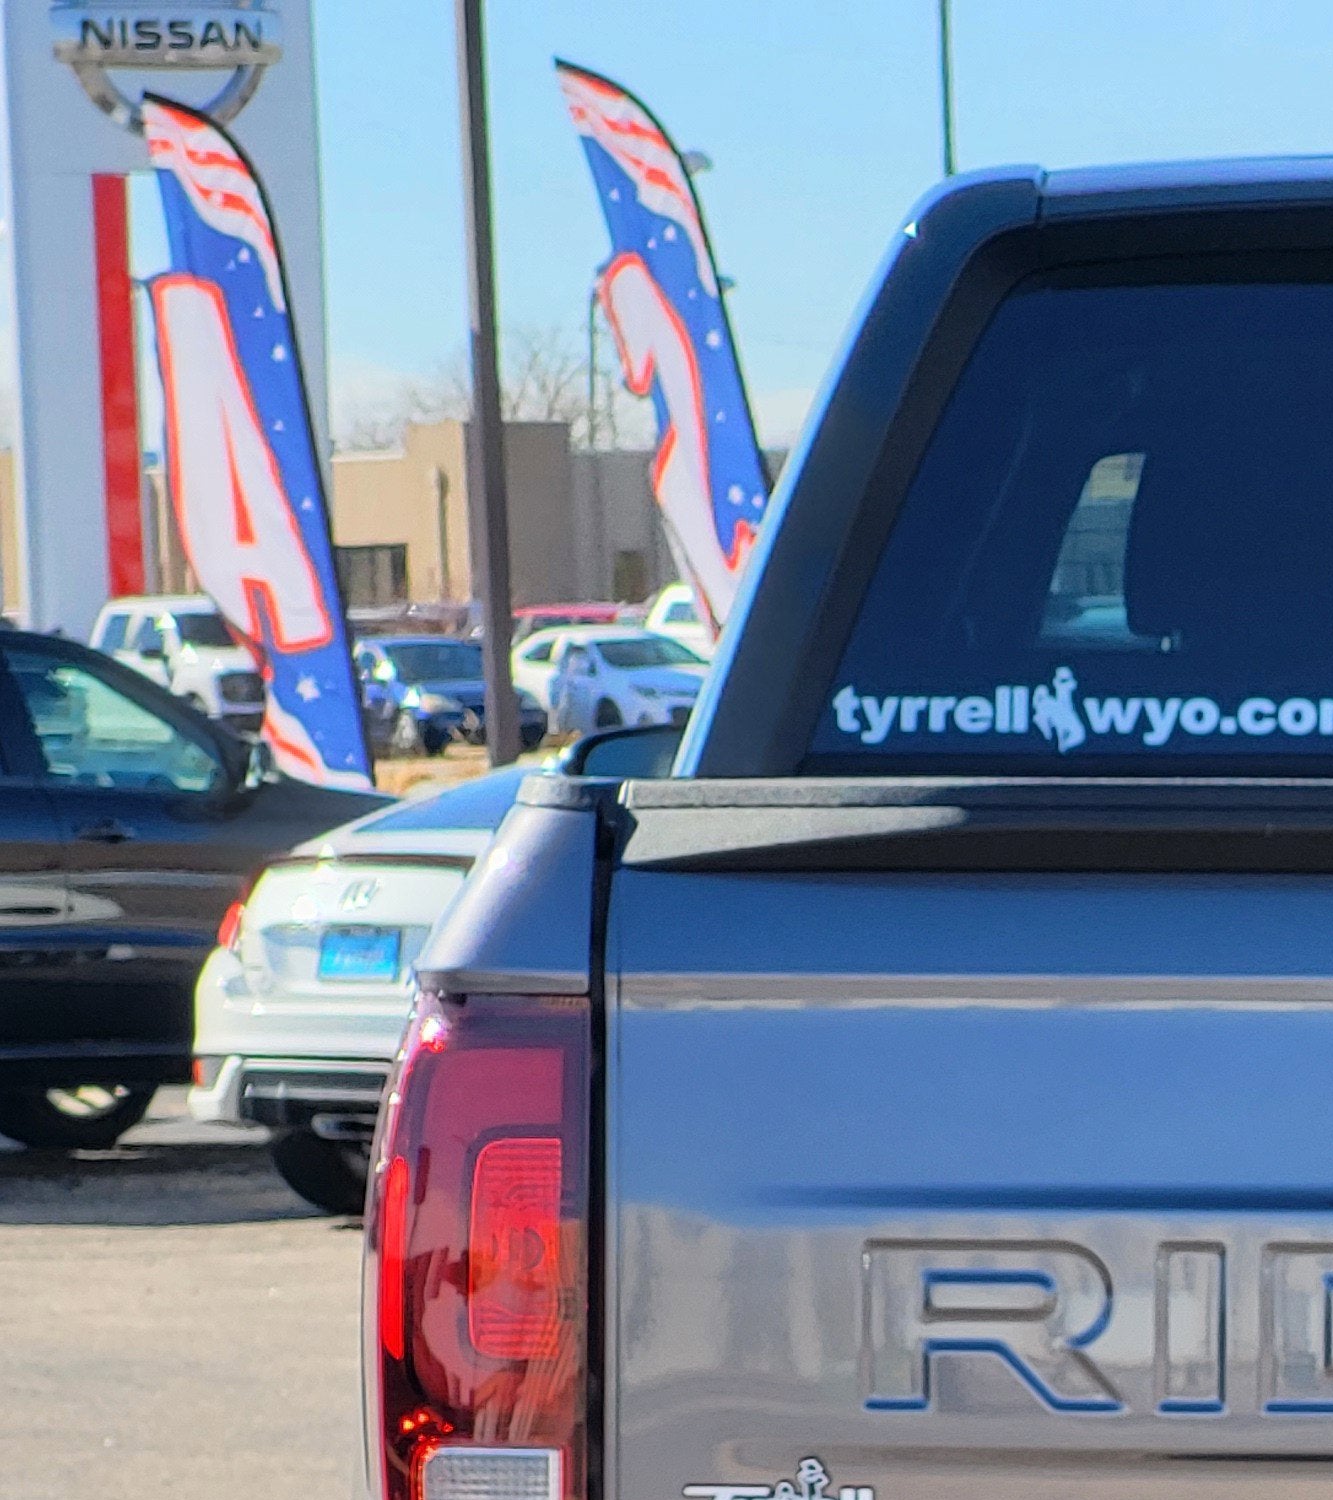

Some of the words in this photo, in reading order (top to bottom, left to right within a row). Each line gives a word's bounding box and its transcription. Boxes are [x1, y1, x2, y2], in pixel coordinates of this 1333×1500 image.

[81, 18, 262, 50] NISSAN
[151, 273, 333, 652] A
[833, 685, 1029, 744] tyrrell
